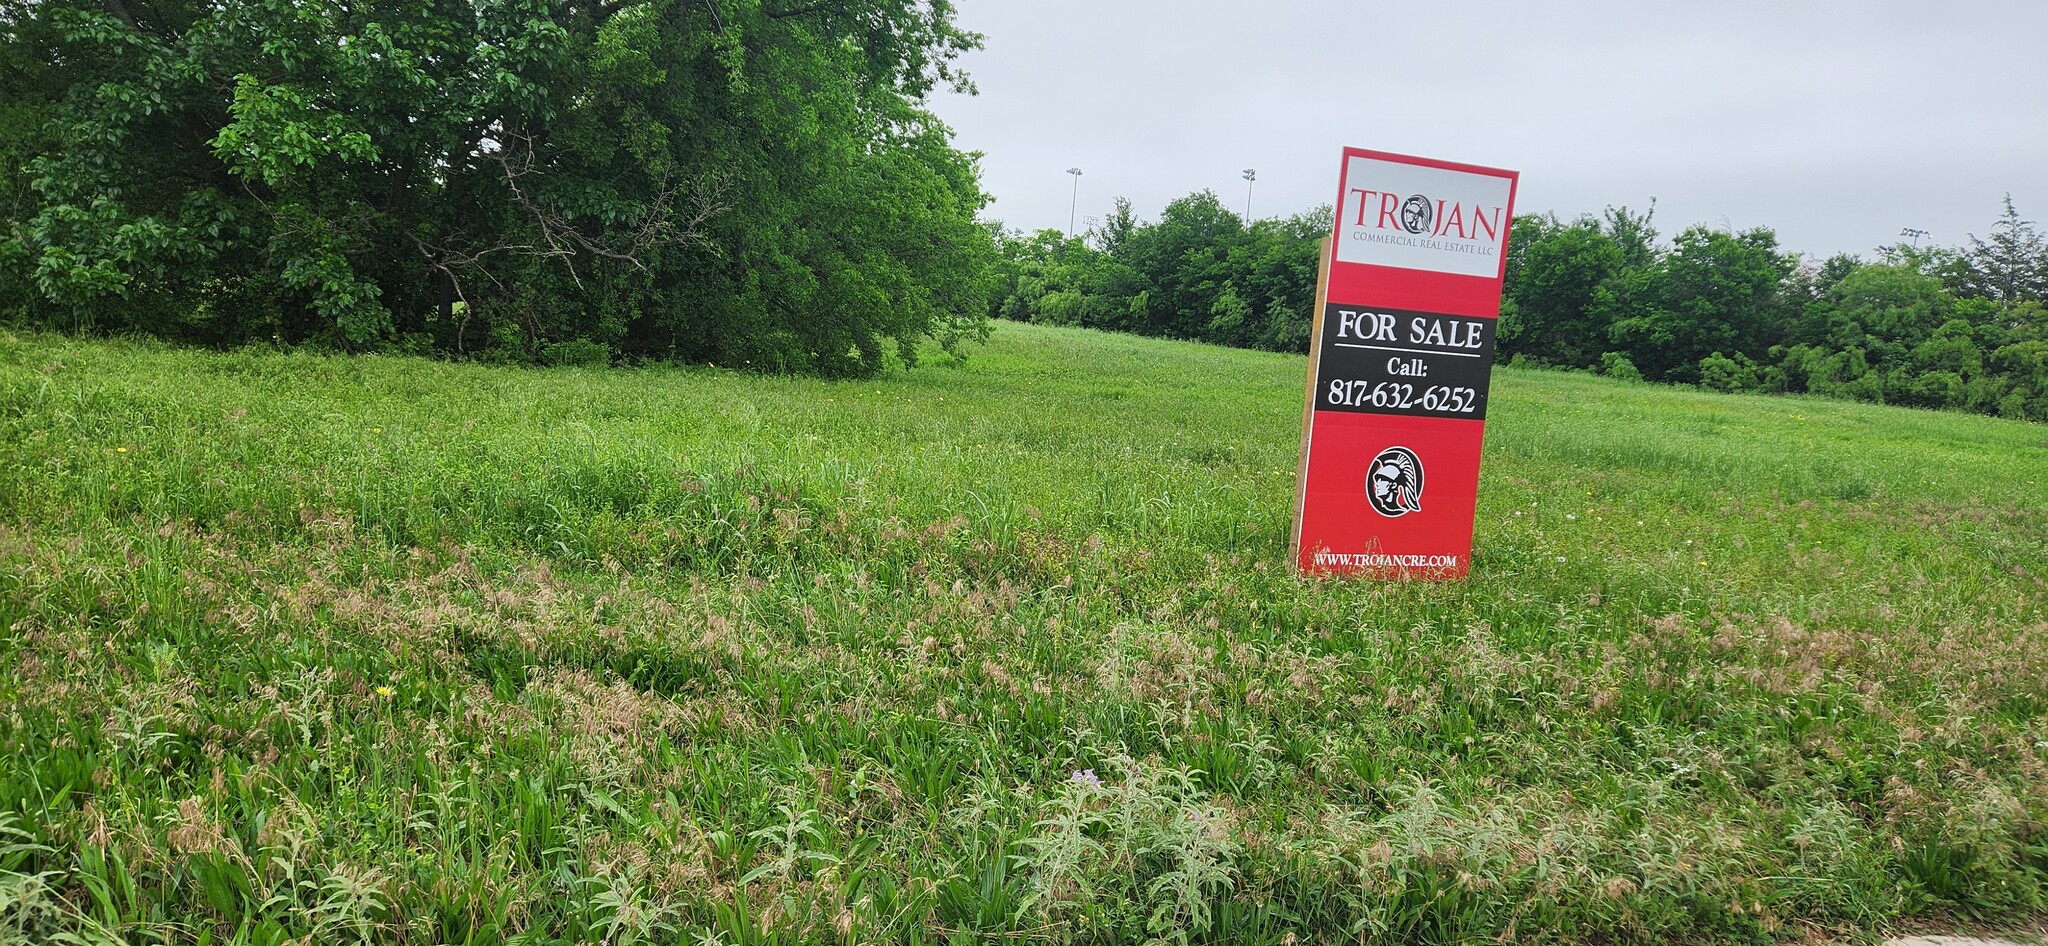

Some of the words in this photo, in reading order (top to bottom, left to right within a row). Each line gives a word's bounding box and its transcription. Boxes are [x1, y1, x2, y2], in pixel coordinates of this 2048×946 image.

[1351, 187, 1503, 242] TROJAN
[1353, 231, 1418, 248] COMMERCIAL
[1420, 239, 1442, 250] REAL
[1444, 243, 1475, 254] ESTATE
[1477, 246, 1494, 256] LLC
[1337, 310, 1398, 342] FOR
[1410, 317, 1484, 349] SALE
[1387, 356, 1428, 377] Call:
[1328, 378, 1476, 413] 817-632-6252
[1314, 553, 1457, 568] WWW.TROJANCRE.COM
